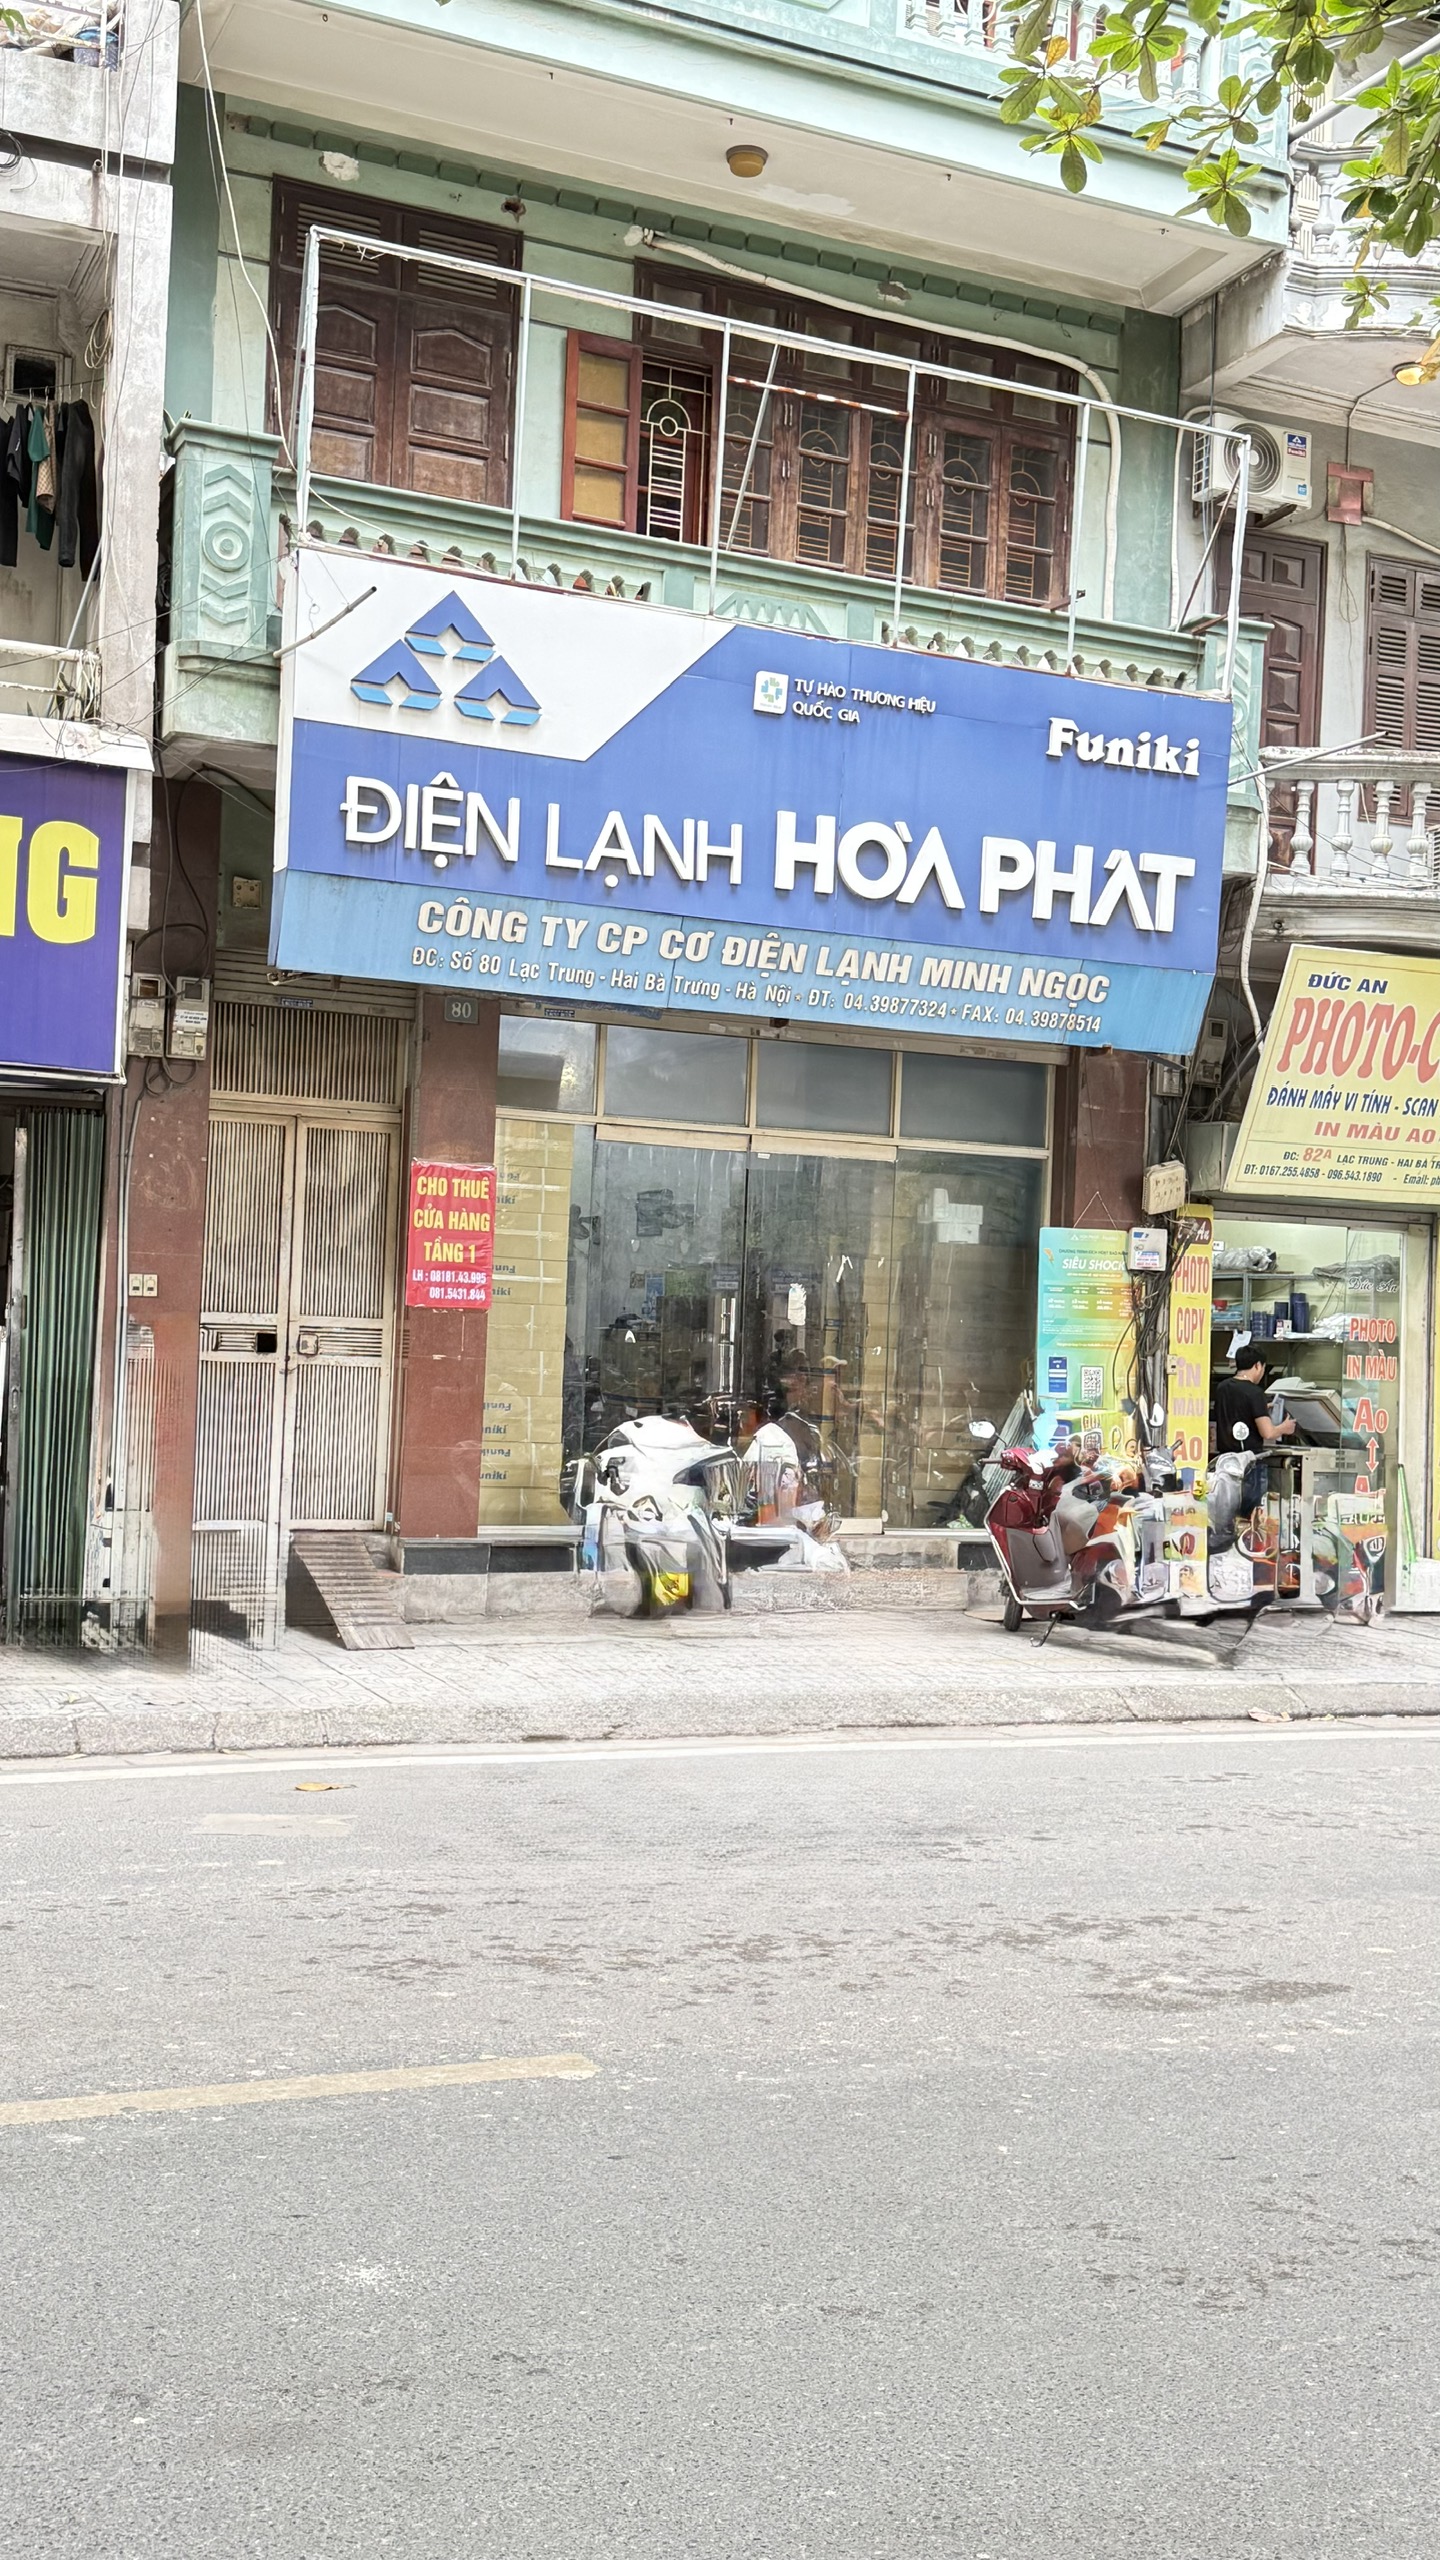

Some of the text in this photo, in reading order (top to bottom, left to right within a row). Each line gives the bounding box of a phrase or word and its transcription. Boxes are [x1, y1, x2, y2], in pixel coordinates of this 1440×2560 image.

[794, 679, 936, 714] TỰ HÀO THƯƠNG HIỆU
[792, 700, 833, 719] QUỐC
[838, 708, 860, 723] GIA
[1046, 717, 1199, 776] Funiki
[340, 771, 520, 868] ĐIỆN
[545, 803, 743, 887] LẠNH
[979, 835, 1196, 933] PHÁT
[417, 896, 1110, 1008] CÔNG TY CP CƠ ĐIỆN LẠNH MINH NGỌC
[412, 946, 444, 968] ĐC:
[450, 948, 477, 971] Số
[479, 954, 501, 975] 80
[509, 958, 540, 983] Lạc
[549, 962, 595, 989] Trung
[610, 968, 639, 990] Hai
[644, 972, 666, 992] Bà
[674, 975, 720, 1000] Trưng
[735, 978, 757, 1000] Hà
[765, 984, 792, 1007] Nội
[808, 989, 835, 1008] ĐT:
[843, 992, 947, 1018] 04.39877324
[961, 1003, 999, 1023] FAX:
[1307, 971, 1388, 994] ĐỨC AN
[452, 1002, 471, 1018] 80
[1266, 1081, 1308, 1108] ĐÁNH
[1344, 1092, 1358, 1111] VI
[1361, 1089, 1392, 1114] TÍNH
[1402, 1097, 1439, 1117] SCAN
[1314, 1121, 1340, 1137] IN
[1346, 1122, 1400, 1141] MÀU
[1283, 1151, 1299, 1161] ĐC:
[1303, 1147, 1332, 1162] 82A
[1337, 1154, 1355, 1165] LẠC
[1358, 1156, 1388, 1166] TRUNG
[1397, 1158, 1413, 1167] HAI
[1415, 1158, 1428, 1168] BÀ
[417, 1176, 489, 1199] CHO THUÊ
[413, 1203, 490, 1232] CỬA HÀNG
[424, 1236, 476, 1264] TẦNG 1
[1062, 1255, 1087, 1269] SIÊU
[1088, 1259, 1125, 1271] SHOCK
[1174, 1255, 1210, 1294] PHOTO
[1176, 1306, 1205, 1345] COPY
[1349, 1318, 1397, 1344] PHOTO
[1346, 1348, 1397, 1382] IN MÀU
